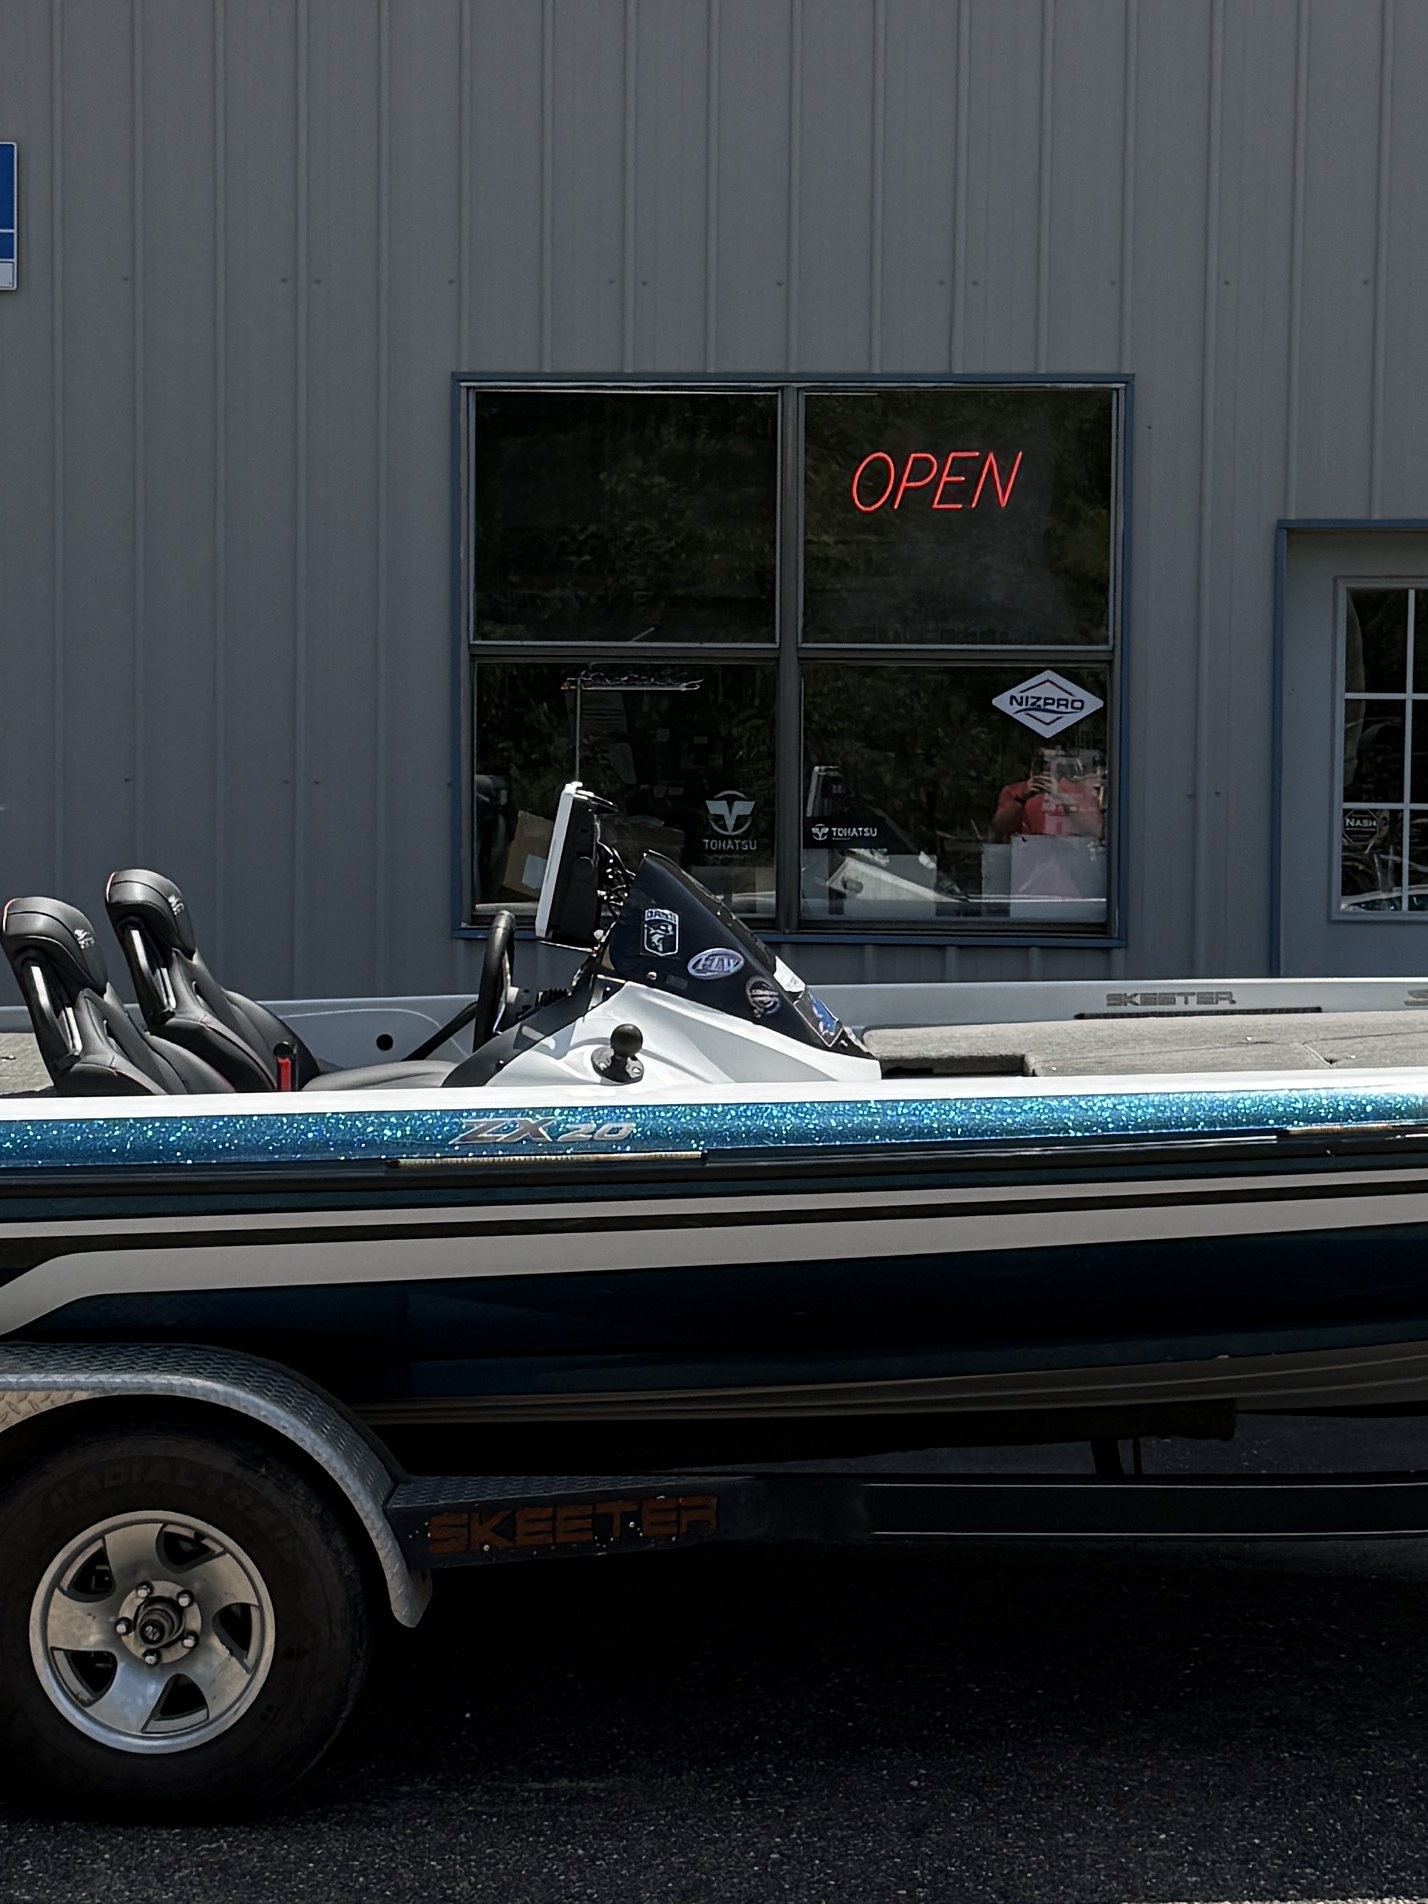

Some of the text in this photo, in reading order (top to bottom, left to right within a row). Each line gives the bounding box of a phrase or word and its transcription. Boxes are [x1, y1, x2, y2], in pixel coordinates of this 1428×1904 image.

[852, 450, 1024, 512] OPEN
[1009, 695, 1085, 711] NIZPRO
[831, 827, 878, 837] TOHATSU
[702, 839, 757, 851] TOHATSU
[429, 1495, 718, 1554] SKEETER
